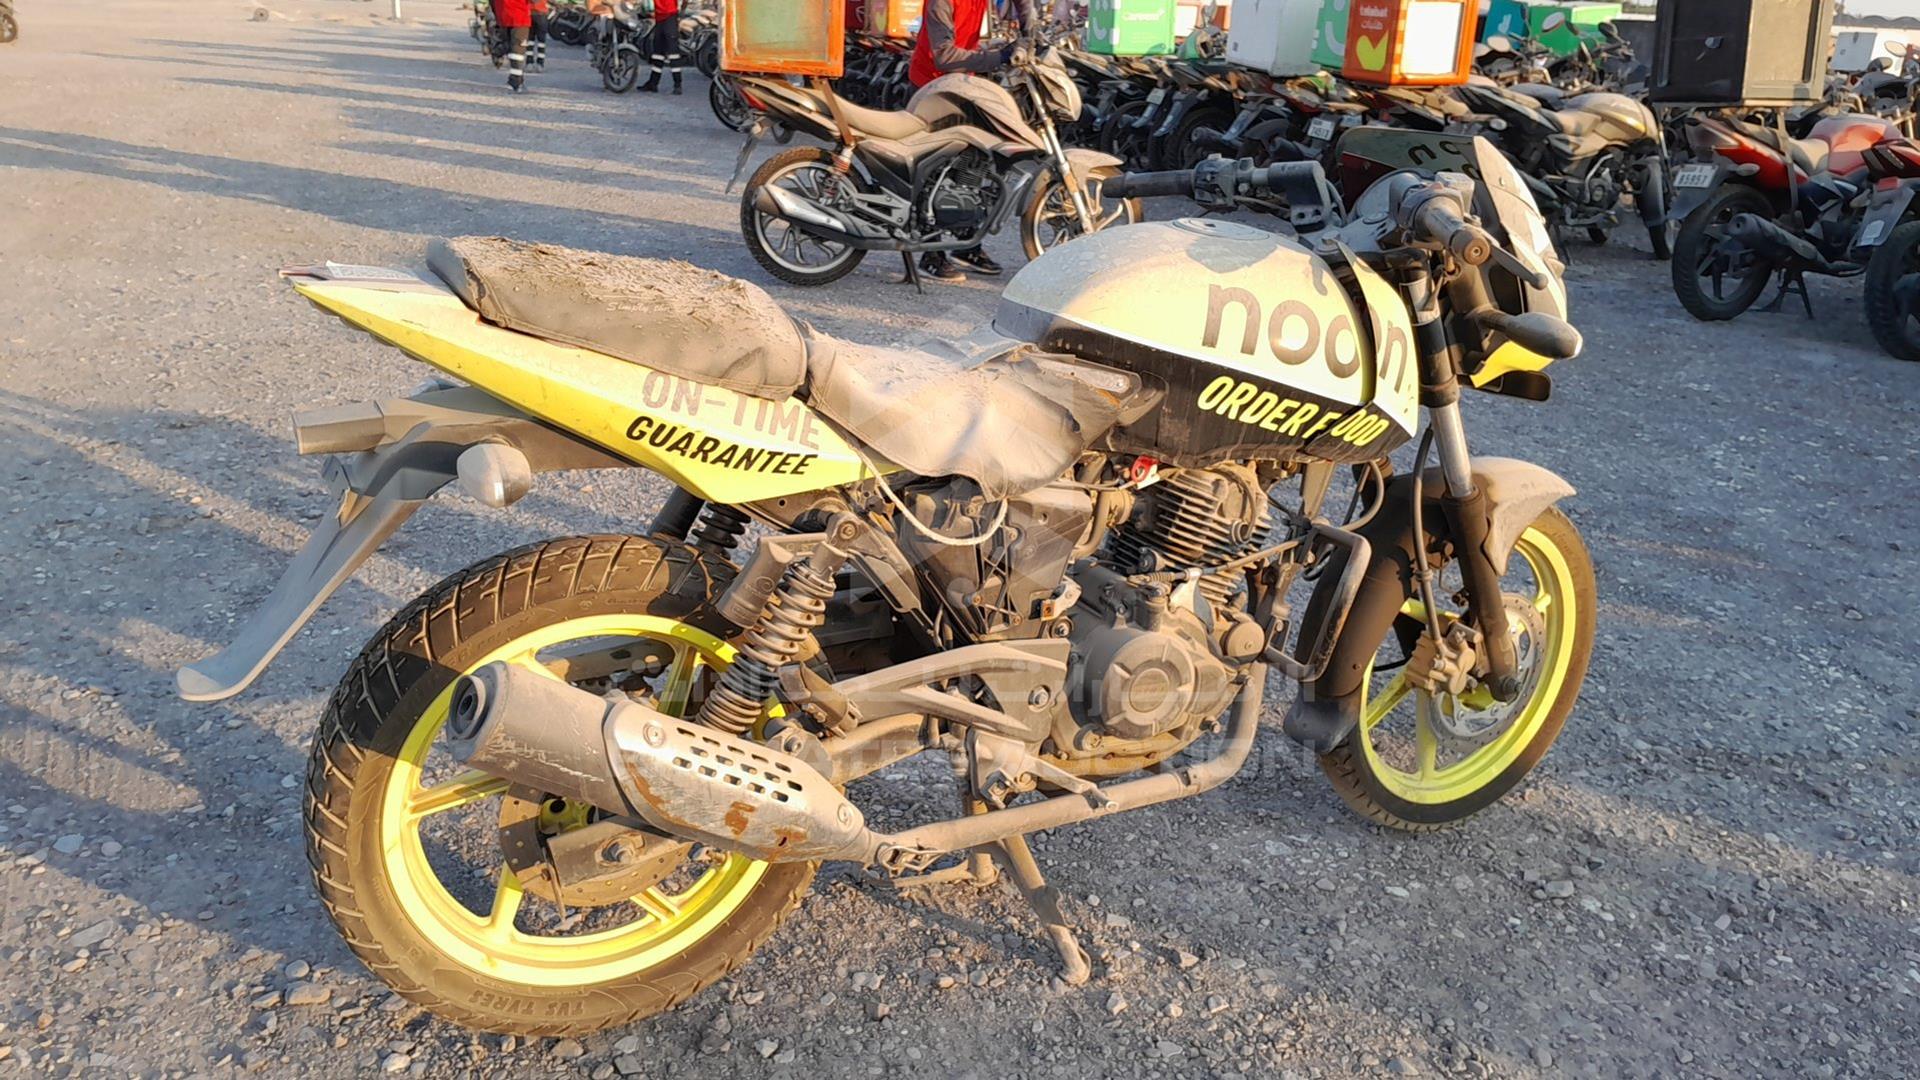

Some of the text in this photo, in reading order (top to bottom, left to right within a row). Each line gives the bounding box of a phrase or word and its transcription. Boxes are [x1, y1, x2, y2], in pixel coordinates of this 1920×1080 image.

[1202, 283, 1408, 395] noon
[625, 415, 819, 476] GUARANTEE
[641, 371, 820, 450] ON-TIME
[1197, 376, 1390, 448] ORDER FOOD
[468, 988, 585, 1017] TVS TYRES
